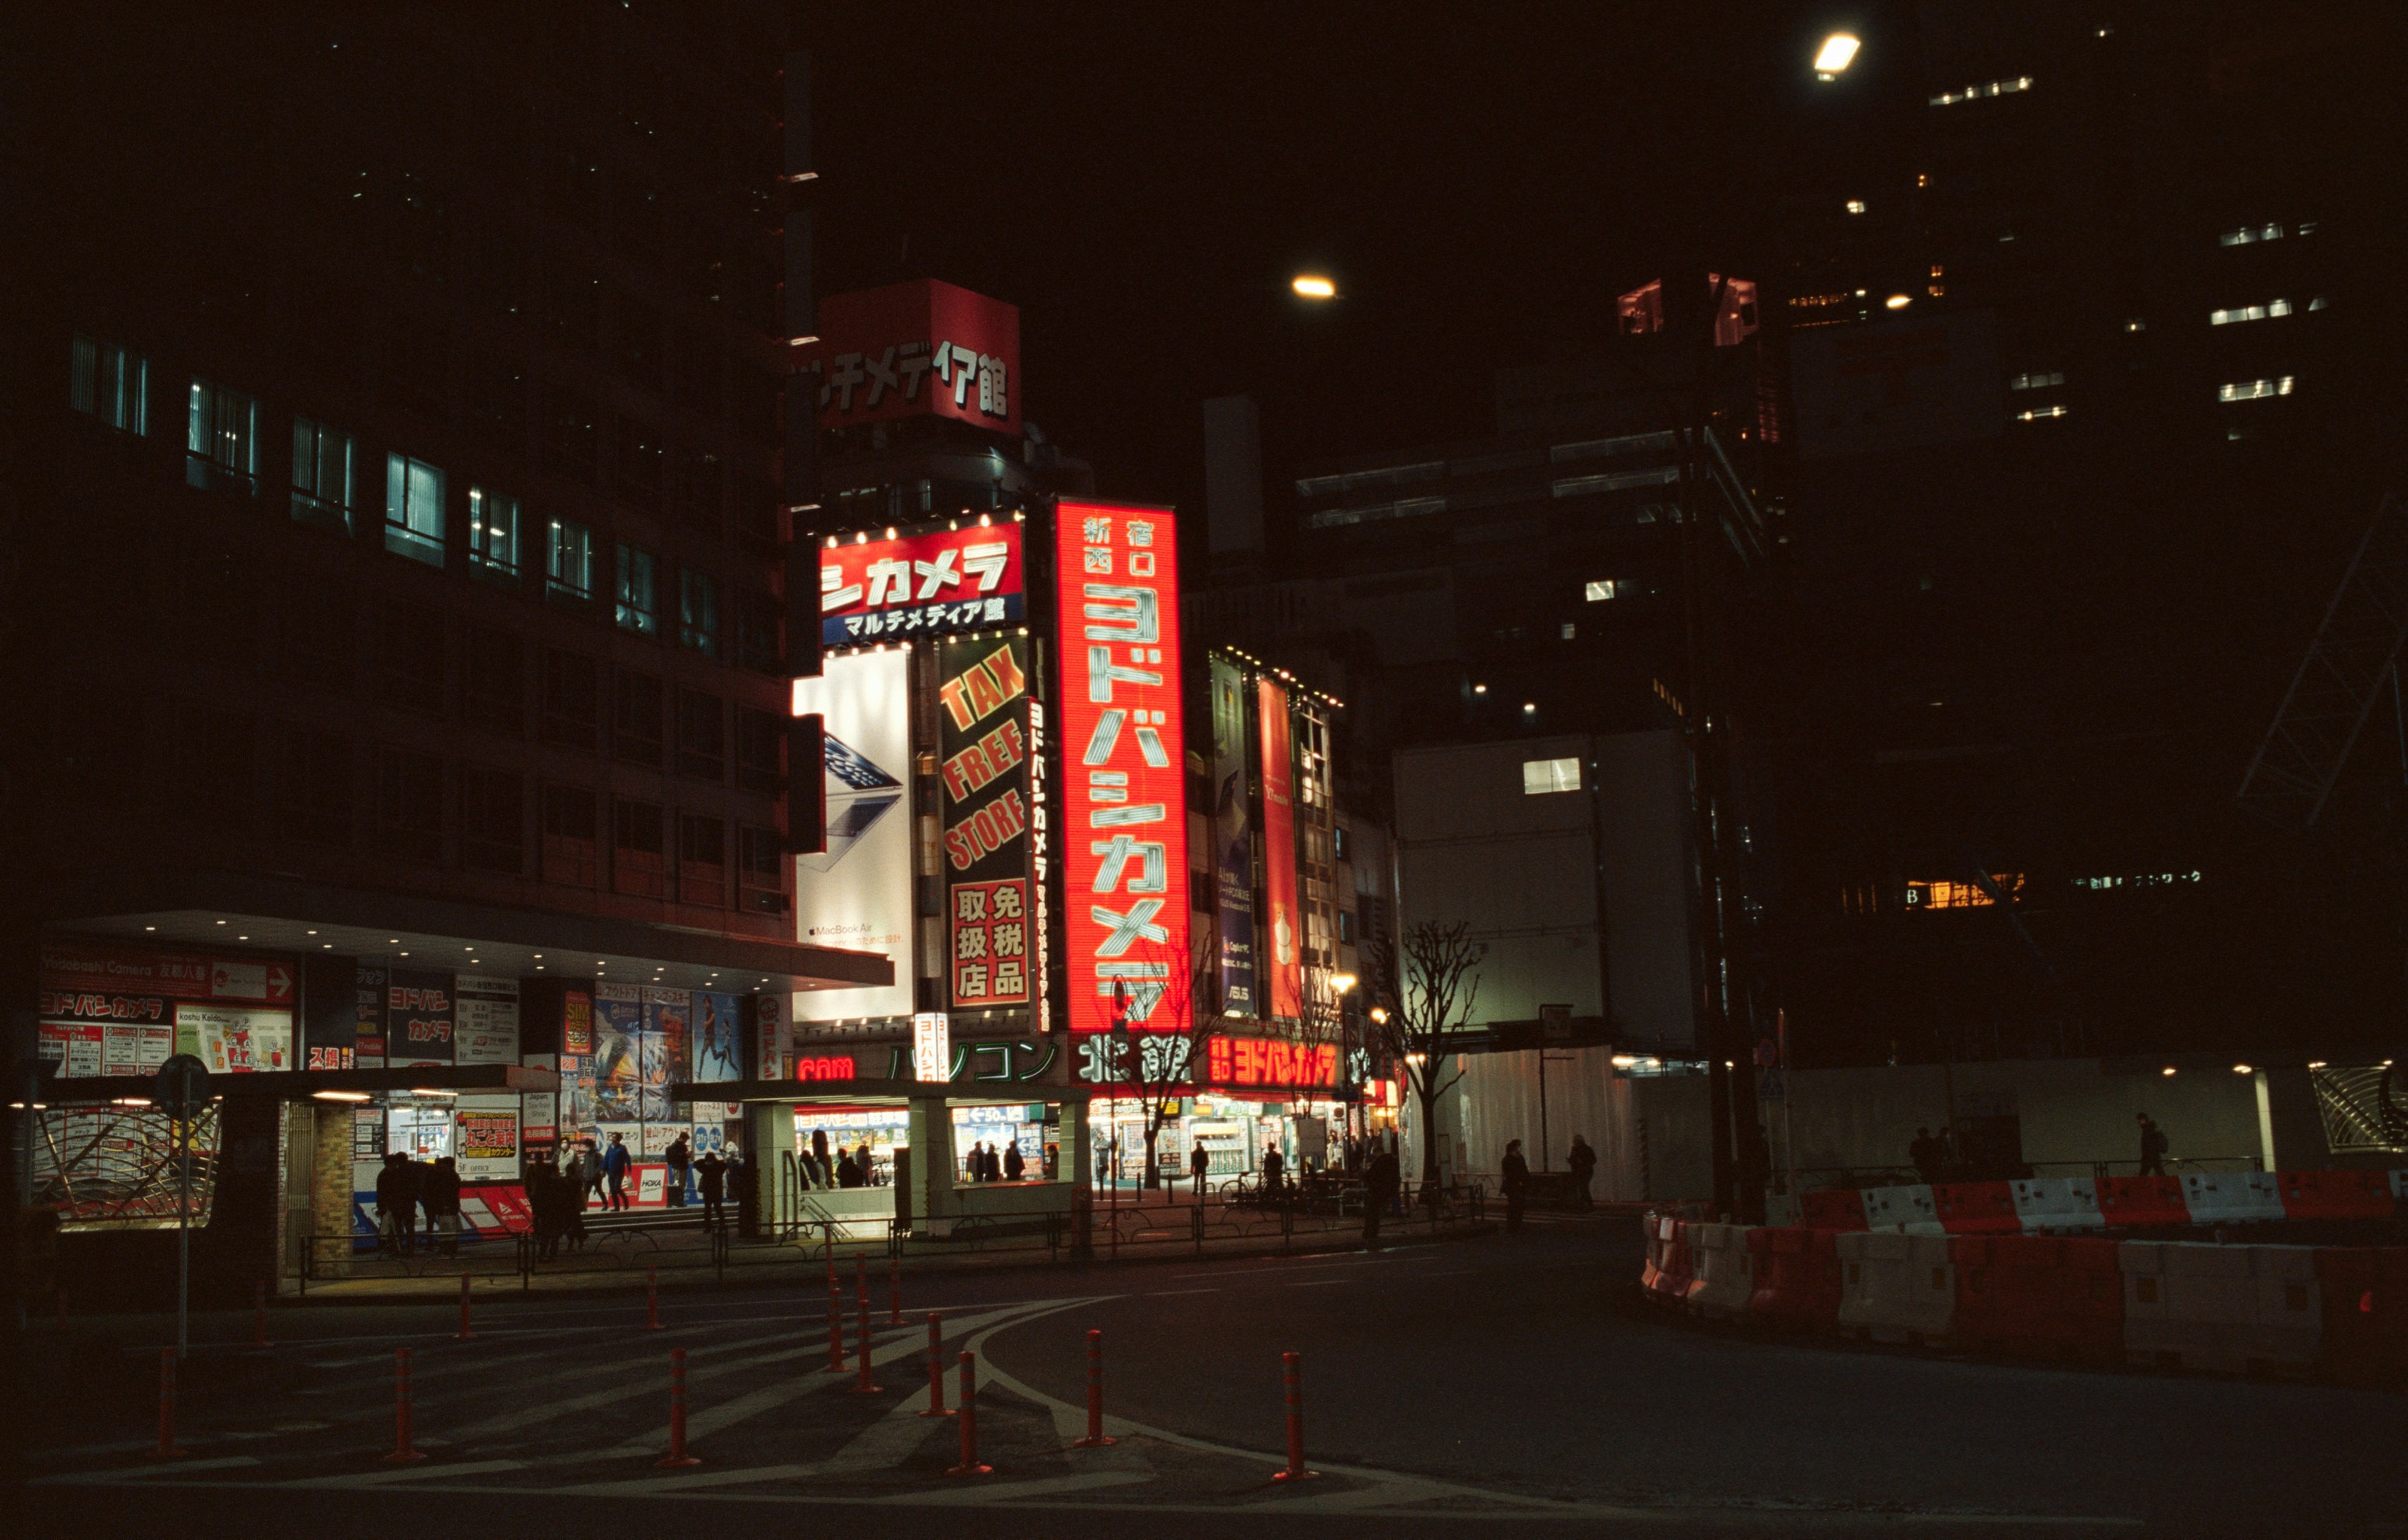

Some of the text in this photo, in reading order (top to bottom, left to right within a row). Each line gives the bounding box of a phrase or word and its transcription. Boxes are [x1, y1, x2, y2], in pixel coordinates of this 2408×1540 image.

[1084, 517, 1154, 547] 新宿
[1084, 547, 1156, 576] 西口
[844, 597, 1006, 637] マルチメディア館
[940, 642, 1025, 732] TAX
[941, 718, 1023, 804] FREE
[1030, 702, 1047, 881] ヨドバシカメラ
[1083, 583, 1170, 1022] ヨドバシカメラ
[944, 787, 1025, 871] STORE
[816, 923, 872, 936] MacBook Air
[40, 992, 163, 1017] ヨドバシカメラ
[390, 987, 449, 1010] ヨドバシ
[409, 1020, 451, 1041] カメラ
[466, 1131, 516, 1147] 丸ごと案内
[642, 1179, 661, 1187] HOKA
